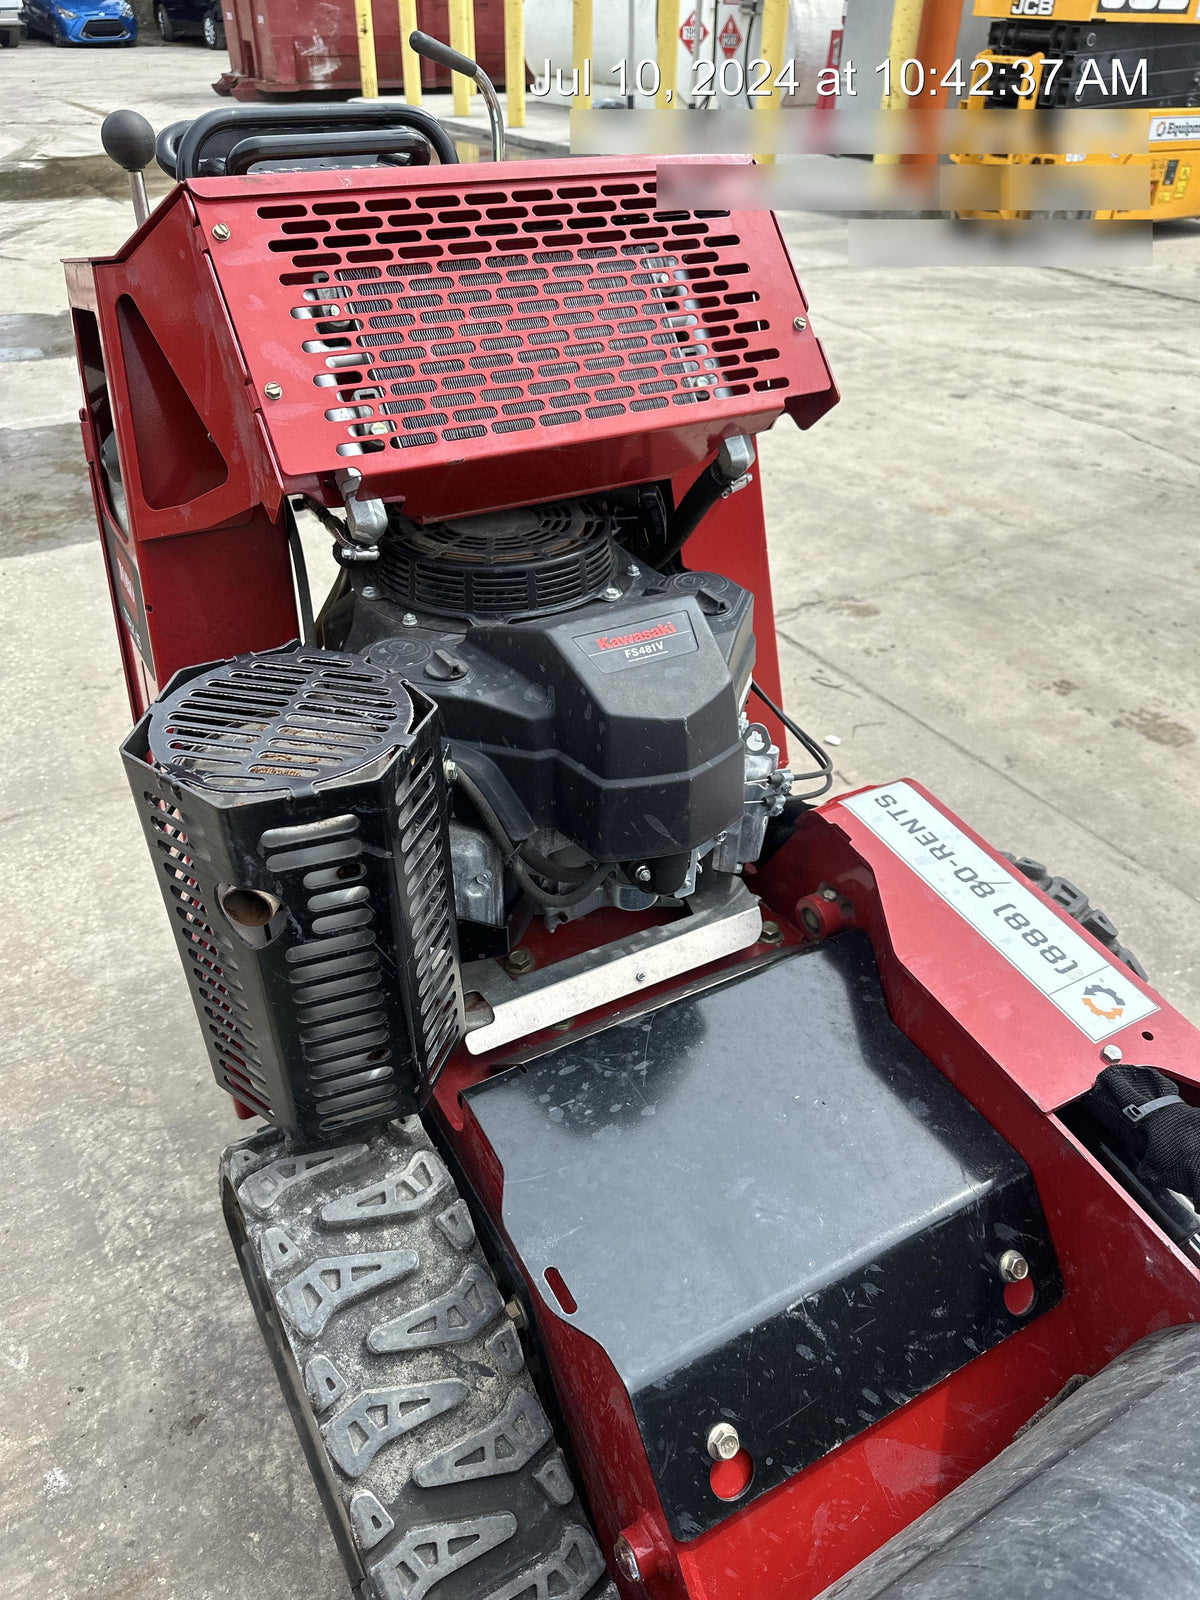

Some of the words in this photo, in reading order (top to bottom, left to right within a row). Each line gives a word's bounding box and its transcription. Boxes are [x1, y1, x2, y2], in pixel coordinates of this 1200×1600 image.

[1011, 0, 1053, 15] JCB
[596, 621, 677, 651] Kawasaki
[624, 641, 664, 659] FS481V
[874, 794, 996, 899] 80-RENTS
[993, 903, 1079, 975] (888)
